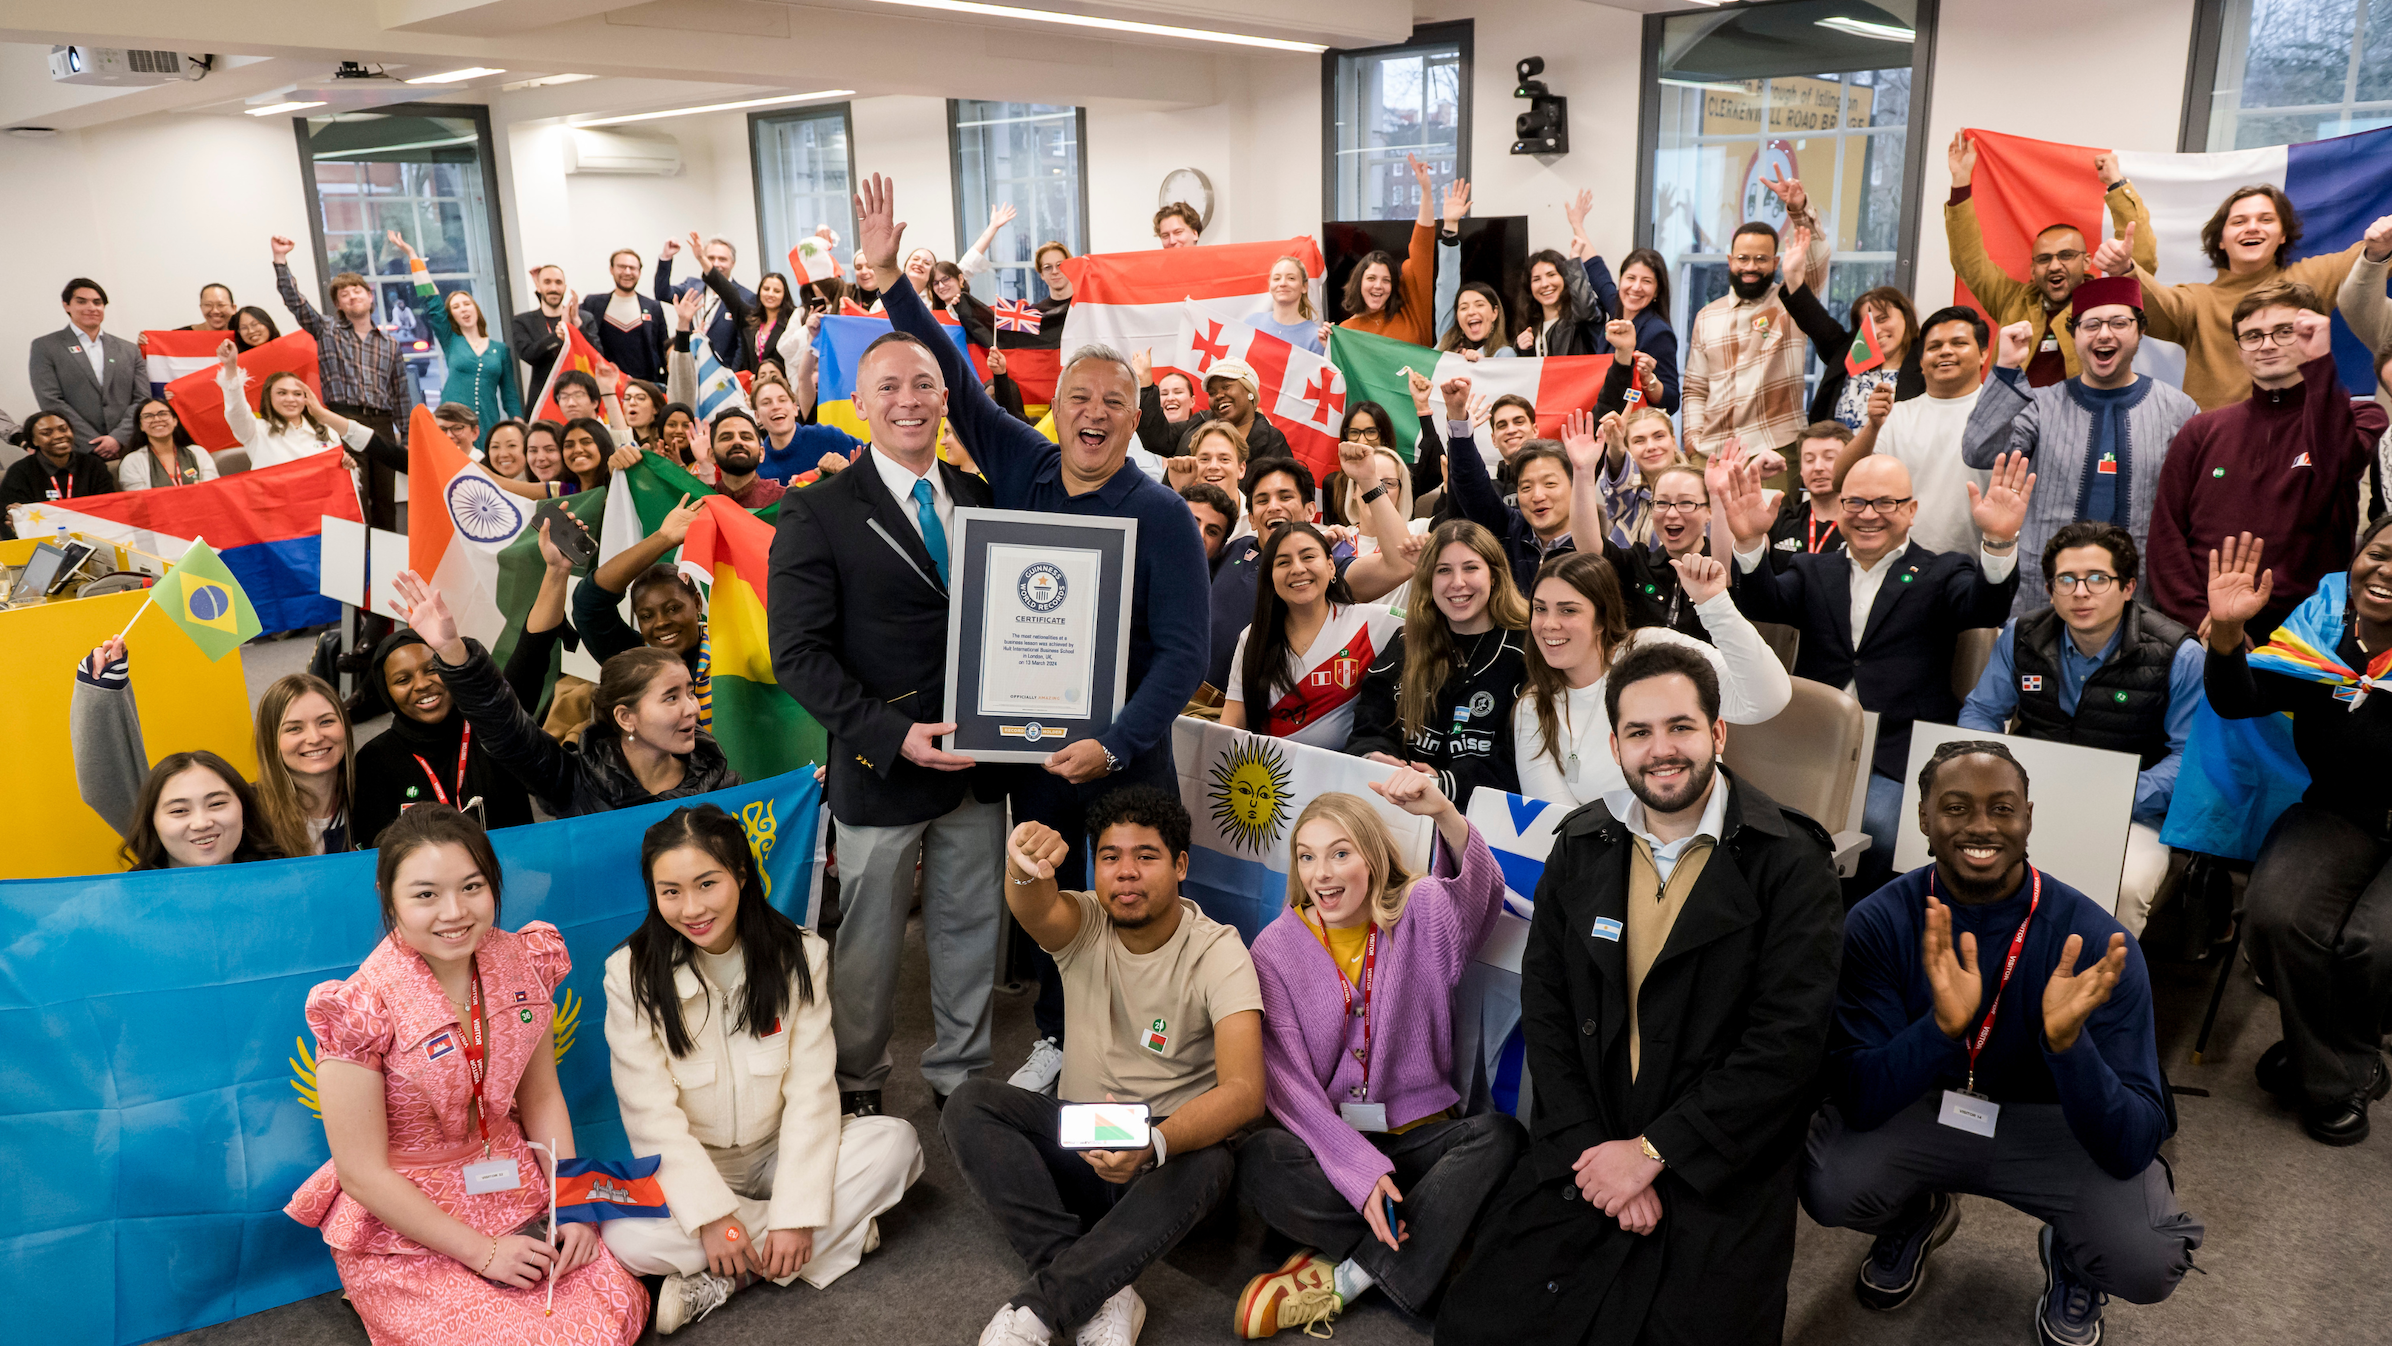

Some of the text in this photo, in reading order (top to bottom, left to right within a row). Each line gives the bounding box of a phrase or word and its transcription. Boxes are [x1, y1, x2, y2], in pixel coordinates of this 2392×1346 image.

[1757, 79, 1797, 105] Brough
[1801, 87, 1812, 104] of
[1815, 89, 1858, 113] Islingon
[1707, 96, 1864, 130] CLERKENWLL ROAD BRGE
[1025, 565, 1062, 580] GUINNESS
[1020, 583, 1066, 611] WORLD RECORDS
[1015, 615, 1066, 625] CERTIFICATE
[1450, 733, 1492, 753] nise
[1368, 932, 1376, 956] VISITOR
[2003, 955, 2017, 981] VISITOR
[1341, 979, 1351, 1003] VISITOR
[521, 1012, 531, 1021] 36
[456, 1028, 469, 1049] VISITO
[473, 1018, 483, 1046] VISITOR
[1975, 1026, 1991, 1050] VISITOR
[469, 1059, 480, 1085] VISITOR
[477, 1095, 486, 1120] VISITOR
[1959, 1108, 1976, 1118] VISITOR
